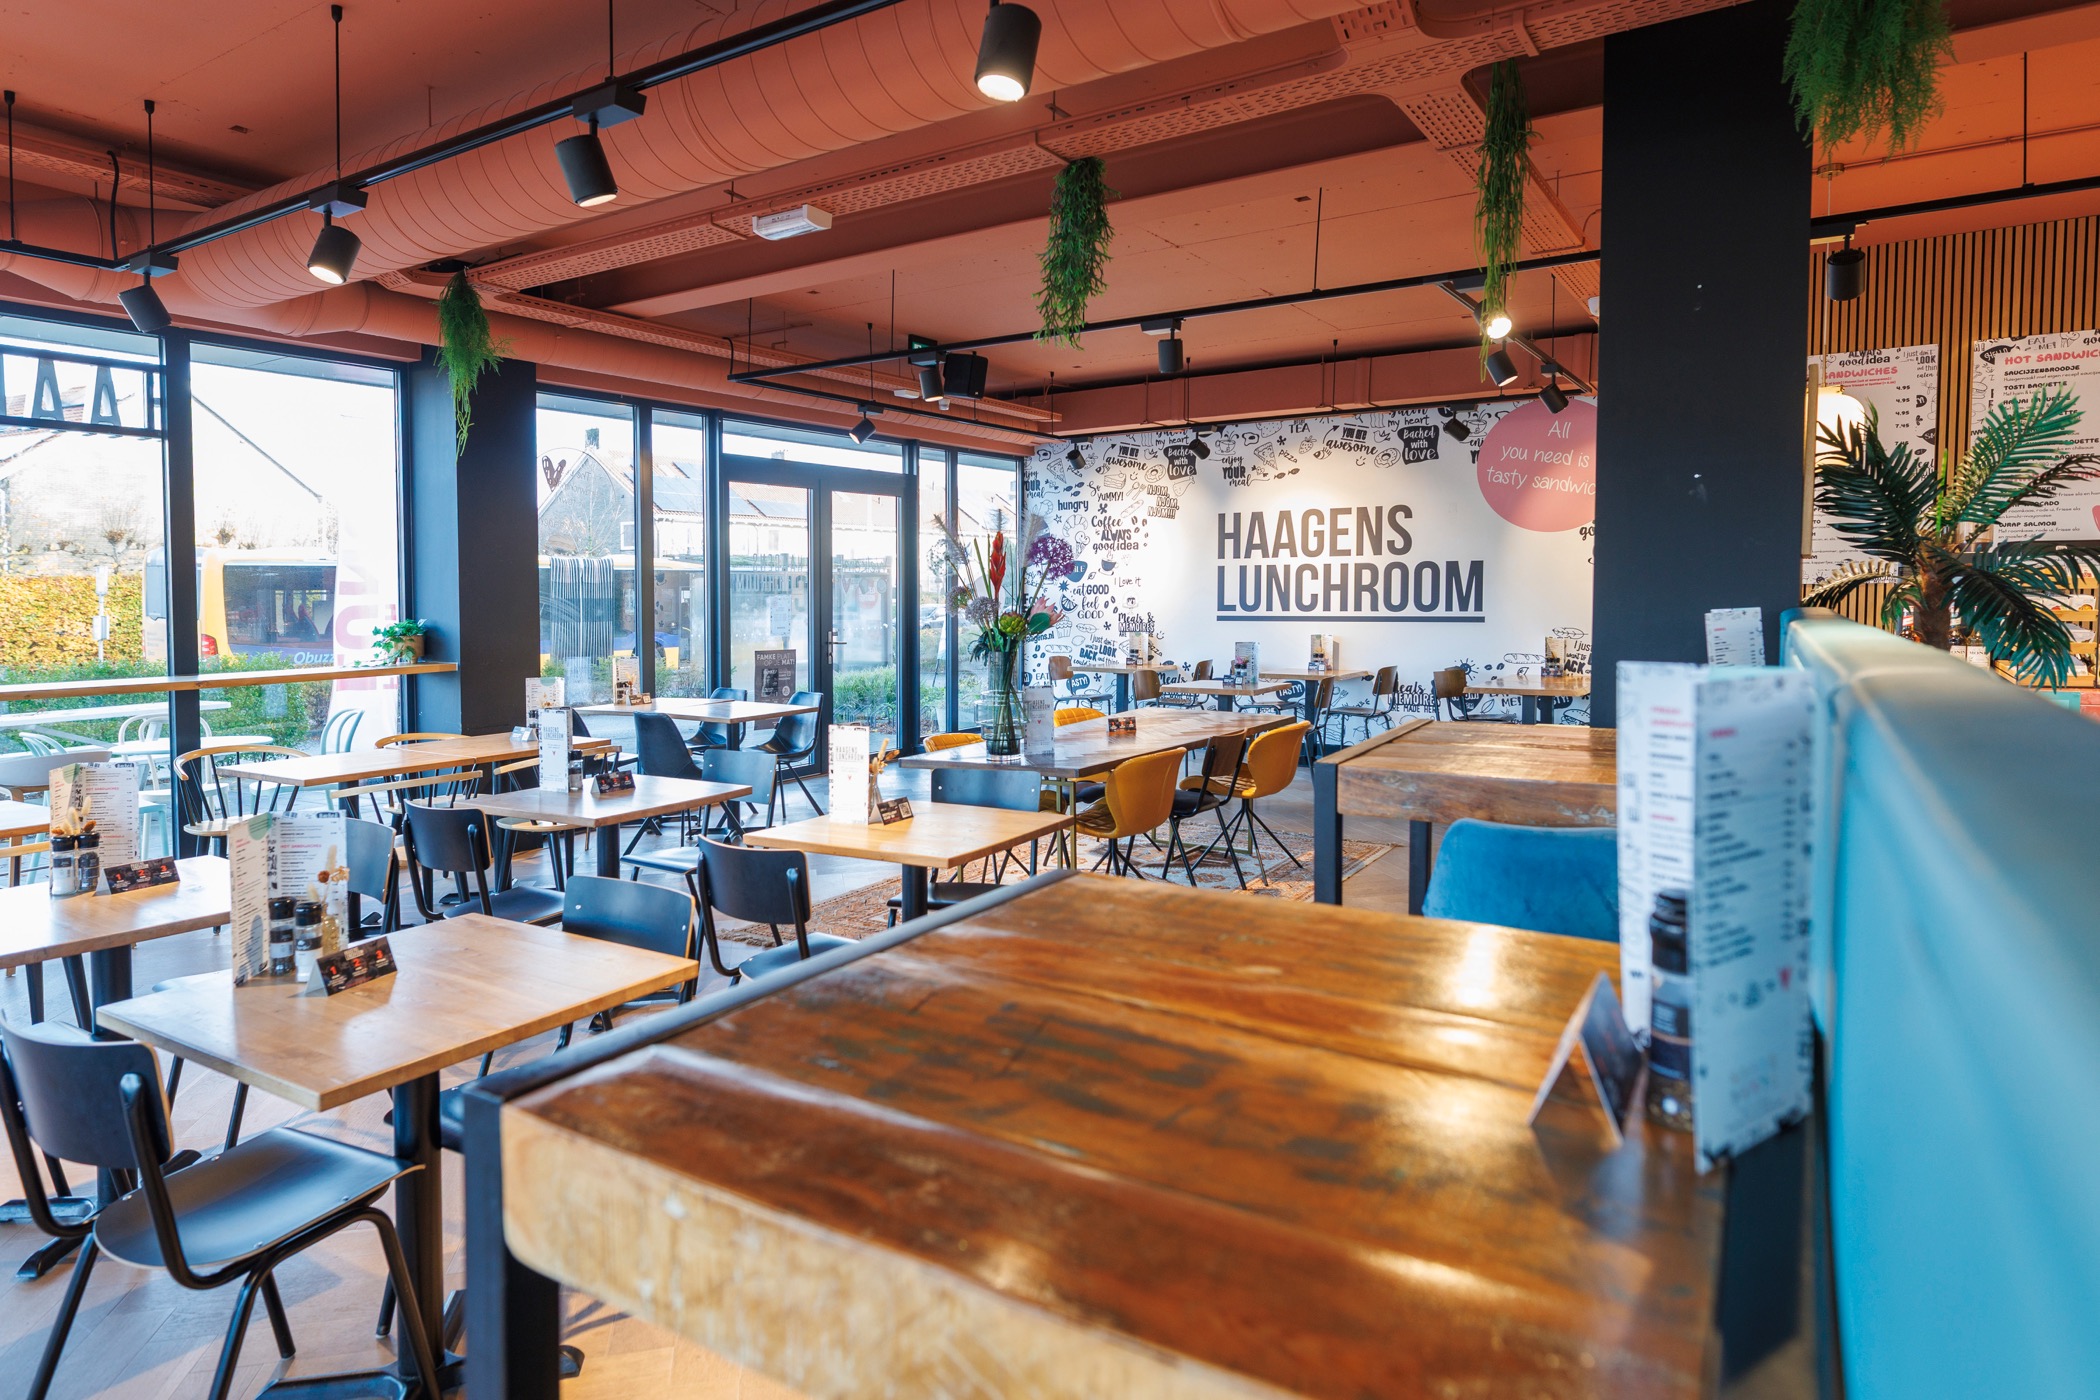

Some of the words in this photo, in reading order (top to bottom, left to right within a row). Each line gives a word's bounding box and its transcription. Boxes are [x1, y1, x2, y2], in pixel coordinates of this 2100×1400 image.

[2028, 336, 2048, 346] EAT
[2038, 342, 2057, 350] ME!
[1906, 350, 1919, 358] just
[2004, 356, 2032, 365] HOT
[2036, 349, 2100, 362] SANDWIC
[1838, 356, 1866, 368] good
[1866, 355, 1890, 365] idea
[1925, 364, 1937, 372] thin
[2004, 365, 2080, 376] SAUCIJZENBROODJE
[1288, 422, 1310, 434] TEA
[1388, 420, 1400, 432] my
[1404, 416, 1430, 426] heart
[1548, 420, 1572, 440] All
[1155, 440, 1166, 450] my
[1168, 436, 1189, 445] heart
[1326, 439, 1378, 456] awesome
[1410, 440, 1428, 448] with
[1168, 448, 1195, 457] Bache
[1278, 449, 1298, 464] pizza
[1404, 448, 1436, 460] love
[1500, 446, 1528, 462] you
[1534, 450, 1574, 466] need
[1578, 452, 1590, 468] is
[1106, 456, 1148, 470] awesome
[1221, 456, 1244, 466] enjoy
[1169, 464, 1195, 476] love
[1222, 466, 1246, 480] YOUR
[1229, 474, 1253, 487] meal
[1486, 465, 1528, 490] tasty
[1025, 480, 1041, 492] OUR
[1026, 486, 1046, 498] meal
[1098, 492, 1124, 502] YUMMY!
[1156, 496, 1180, 510] NJOM,
[1058, 500, 1088, 512] hungry
[1091, 515, 1122, 531] Coffee
[1101, 529, 1132, 542] ALWAYS
[1218, 504, 1412, 559] HAAGENS
[1092, 540, 1116, 554] good
[1116, 540, 1139, 550] idea
[1118, 576, 1134, 588] Love
[1134, 577, 1142, 587] it
[1216, 560, 1484, 612] LUNCHROOM
[1072, 584, 1086, 596] eat
[1086, 584, 1110, 595] GOOD
[1081, 596, 1100, 612] feel
[1077, 610, 1104, 620] GOOD
[1118, 612, 1144, 623] Meals
[1147, 612, 1156, 621] &
[1118, 622, 1155, 632] MEMOIRES
[1026, 630, 1054, 644] aagens.nl
[1099, 645, 1118, 658] LOOK
[1574, 640, 1578, 649] I
[1577, 641, 1591, 652] jus
[1080, 648, 1098, 662] BACK
[1564, 658, 1585, 674] ACK
[1278, 683, 1302, 698] TASTY!
[1400, 681, 1426, 694] eals
[1404, 704, 1420, 712] MADE
[1501, 697, 1522, 707] ME!
[376, 950, 384, 959] 3
[353, 958, 360, 967] 2
[330, 966, 338, 974] 1
